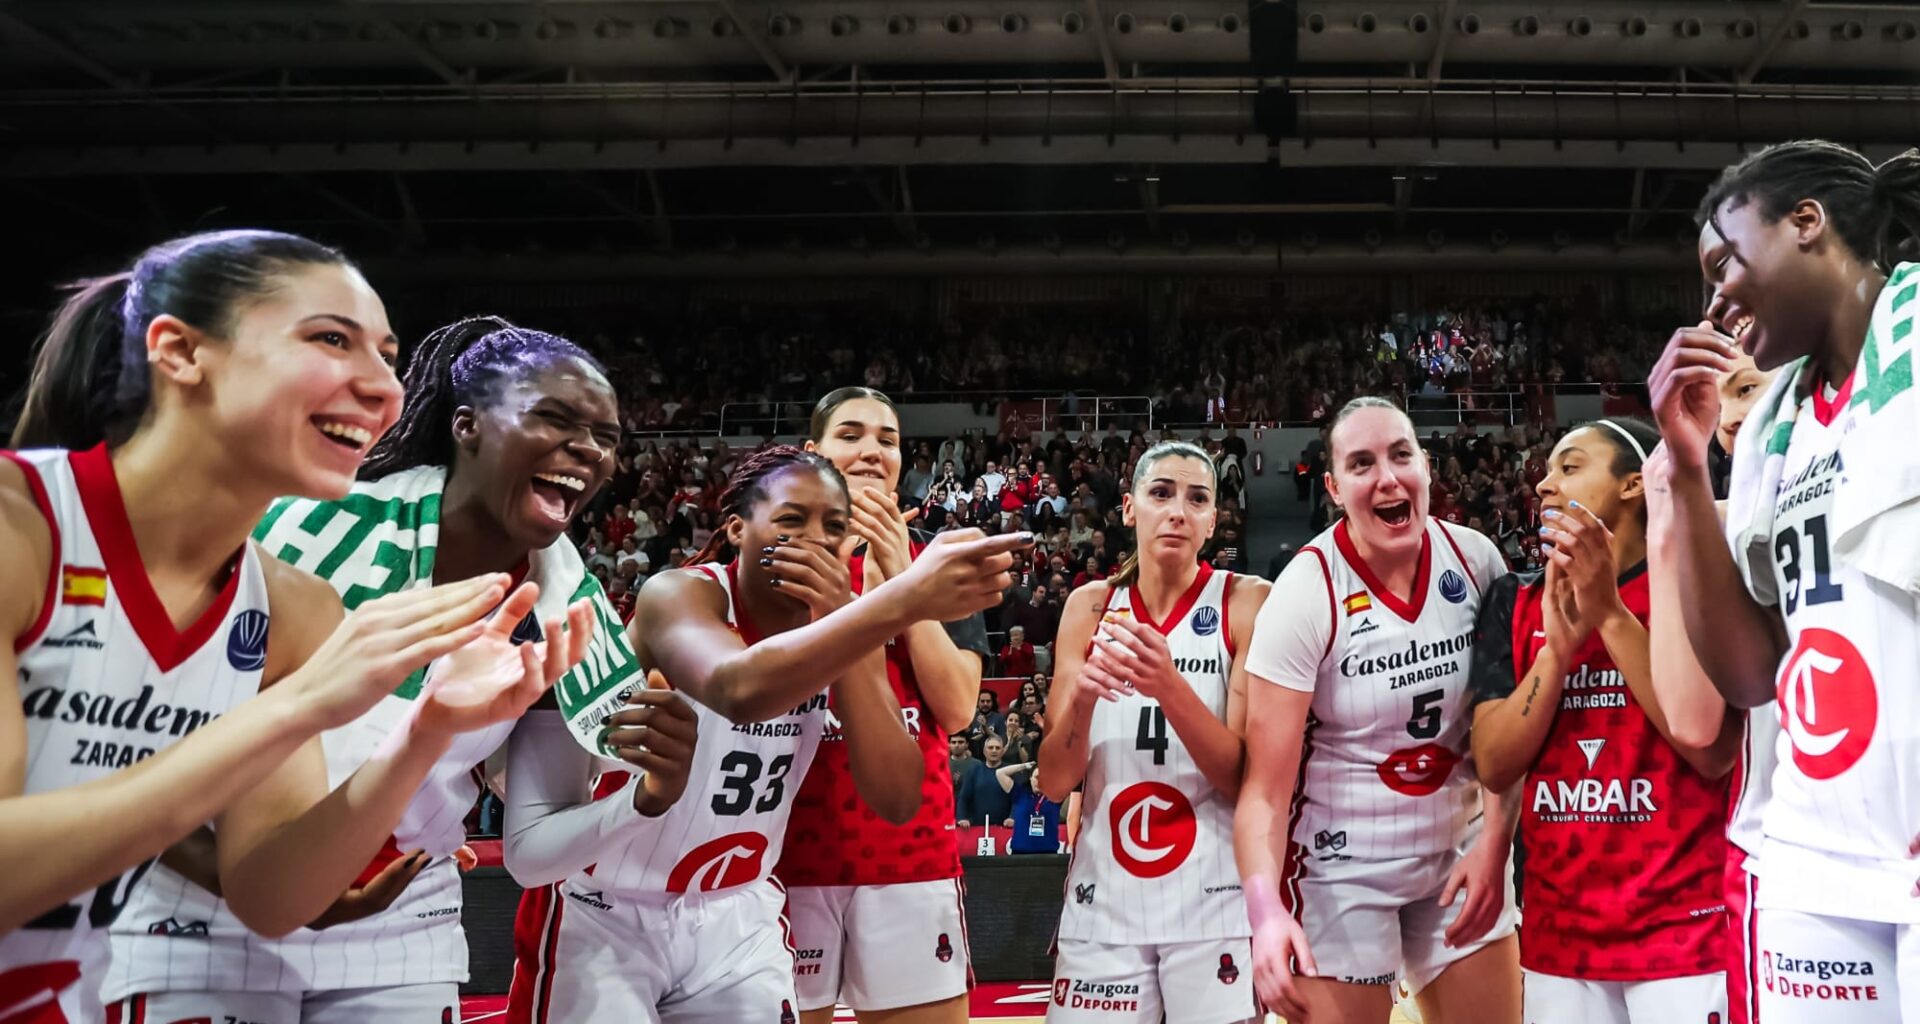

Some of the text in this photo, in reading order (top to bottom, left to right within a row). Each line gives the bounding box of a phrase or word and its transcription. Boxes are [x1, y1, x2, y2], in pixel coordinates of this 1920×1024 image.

[1776, 478, 1834, 520] ZARAGOZ
[1775, 514, 1843, 617] 31
[1389, 660, 1459, 690] ZARAGOZA
[1406, 688, 1445, 740] 5
[1562, 693, 1626, 710] ARAGOZA
[1136, 706, 1169, 766] 4
[711, 750, 794, 816] 33
[1533, 778, 1658, 813] AMBAR
[1776, 952, 1875, 981] Zaragoza
[1073, 979, 1140, 998] Zaragoza
